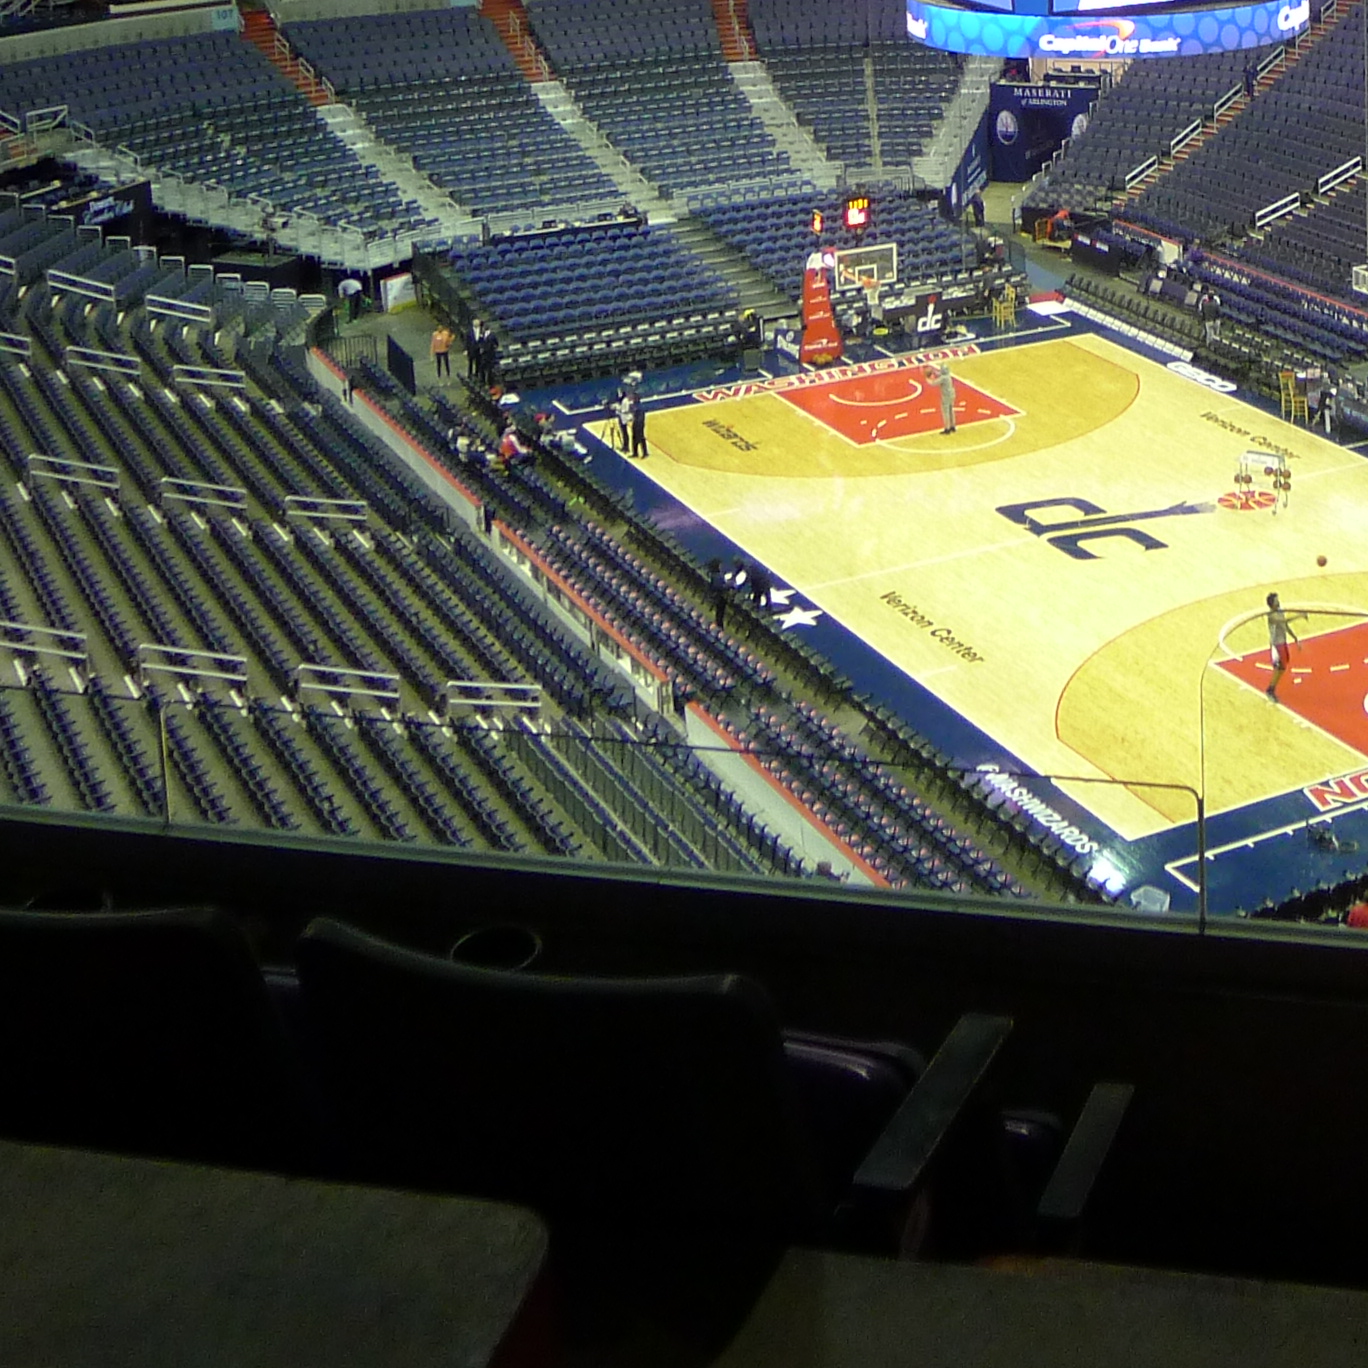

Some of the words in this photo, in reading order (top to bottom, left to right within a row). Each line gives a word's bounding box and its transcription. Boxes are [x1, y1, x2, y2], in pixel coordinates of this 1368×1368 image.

[1013, 87, 1071, 100] MASERATI
[694, 344, 981, 403] WASHINGTON
[879, 589, 935, 630] Verizon
[930, 626, 986, 665] Center
